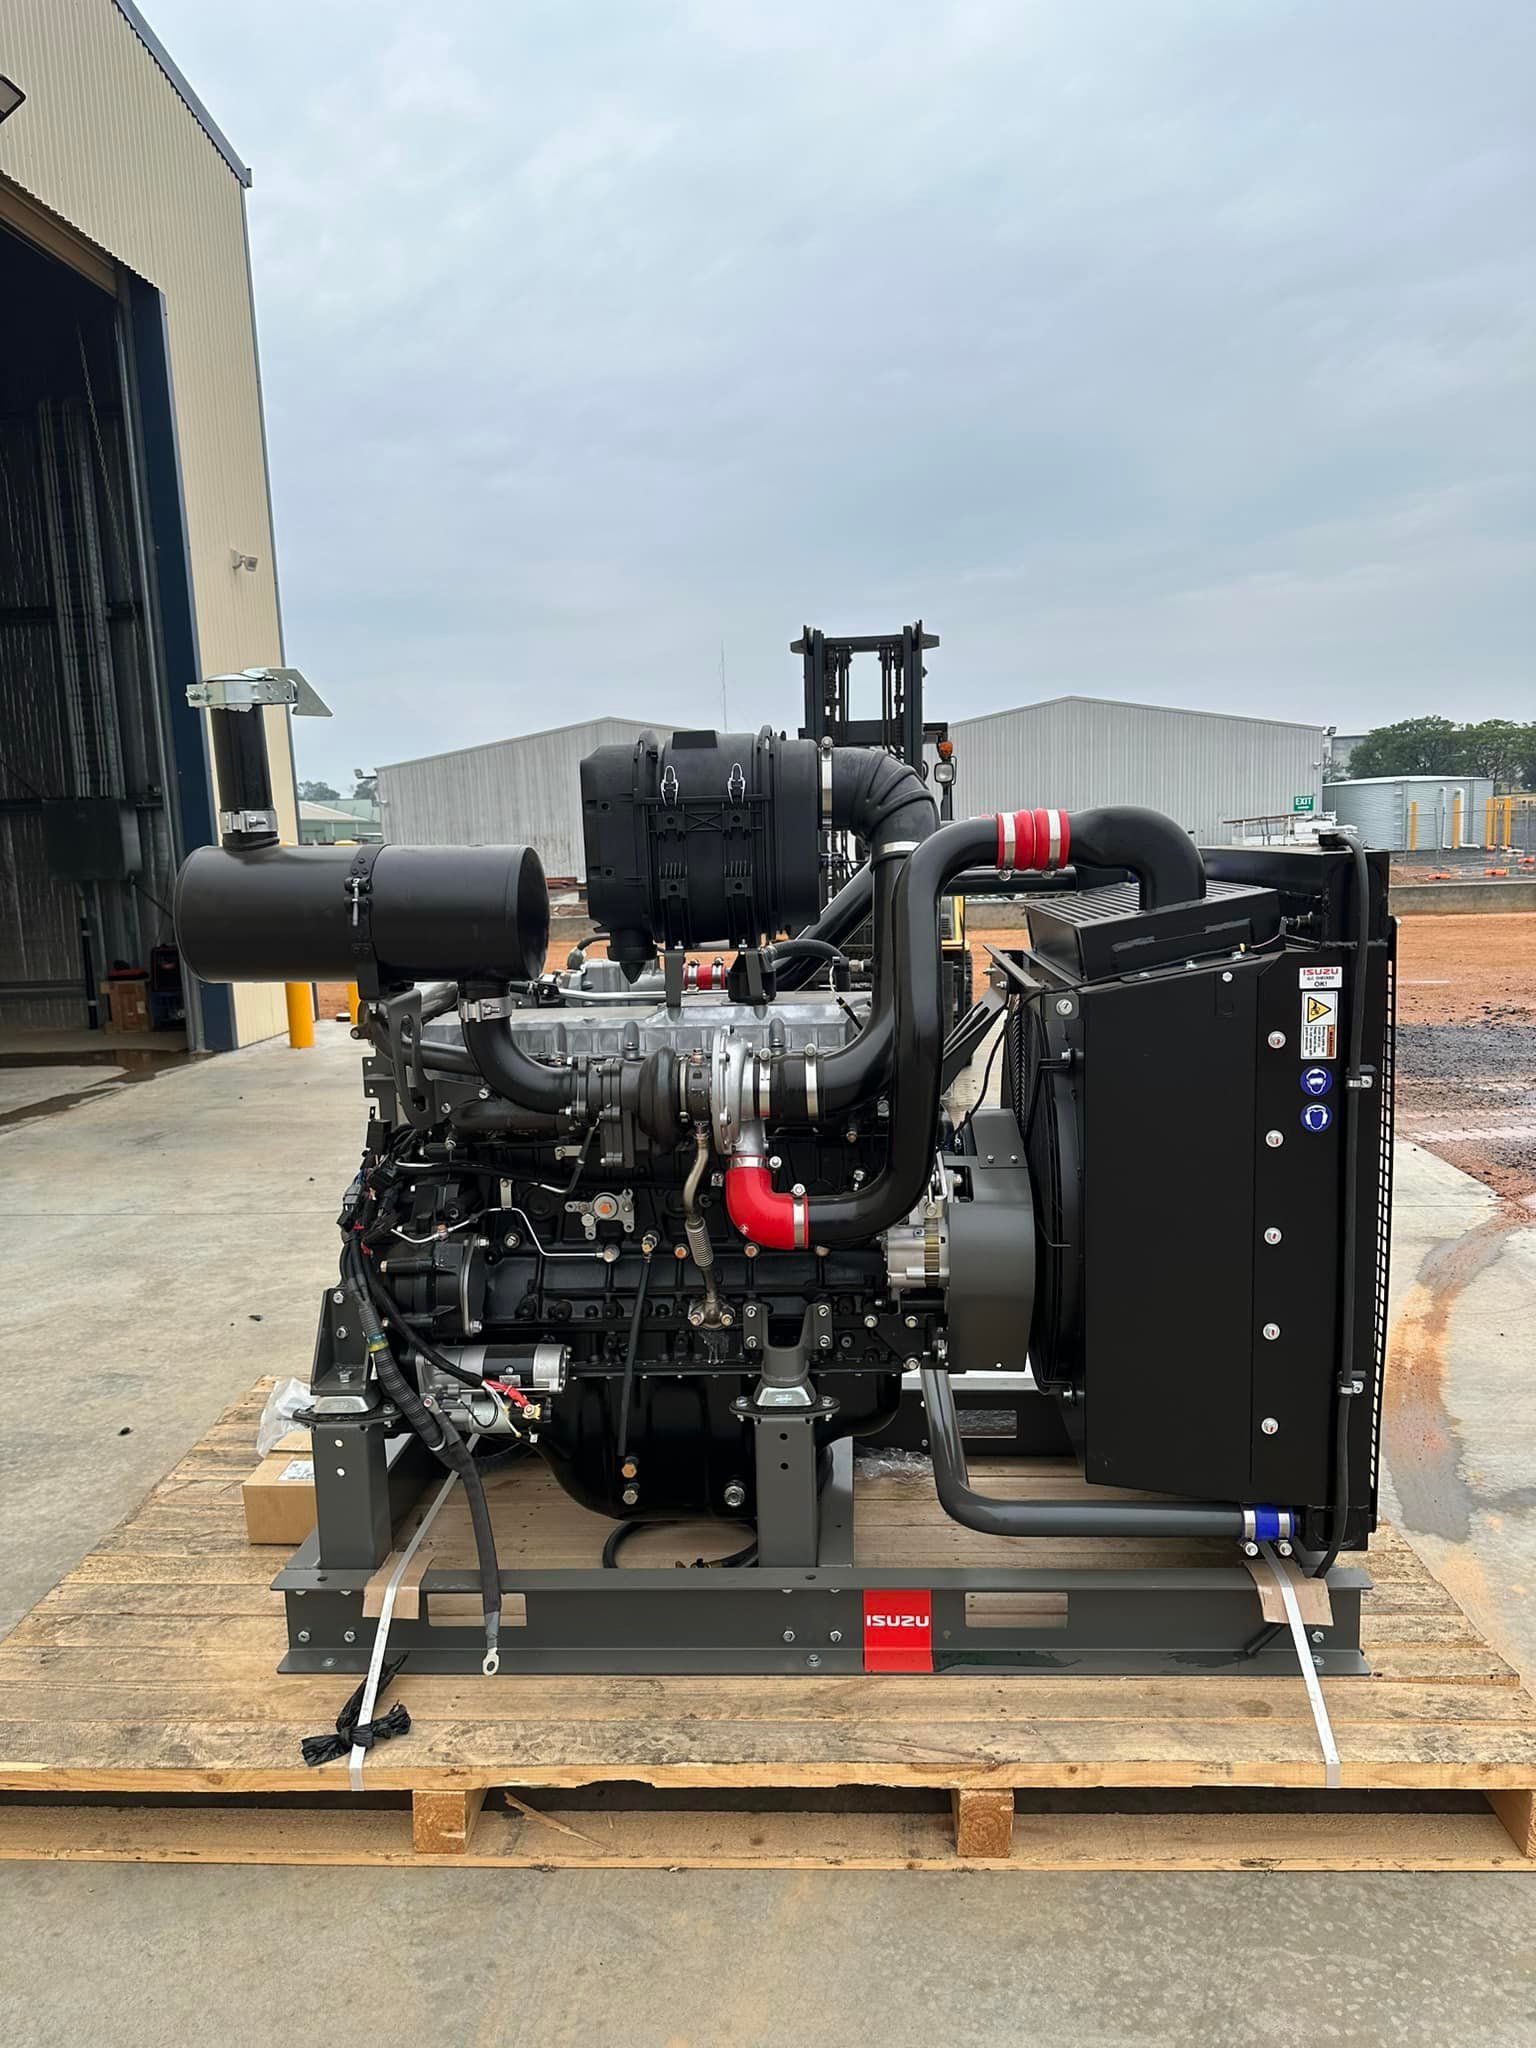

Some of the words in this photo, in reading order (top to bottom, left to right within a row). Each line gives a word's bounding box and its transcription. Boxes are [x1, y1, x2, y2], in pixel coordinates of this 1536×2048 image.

[1296, 797, 1312, 805] EXIT
[1303, 968, 1339, 976] ISUZU
[866, 1615, 930, 1627] ISUZU
